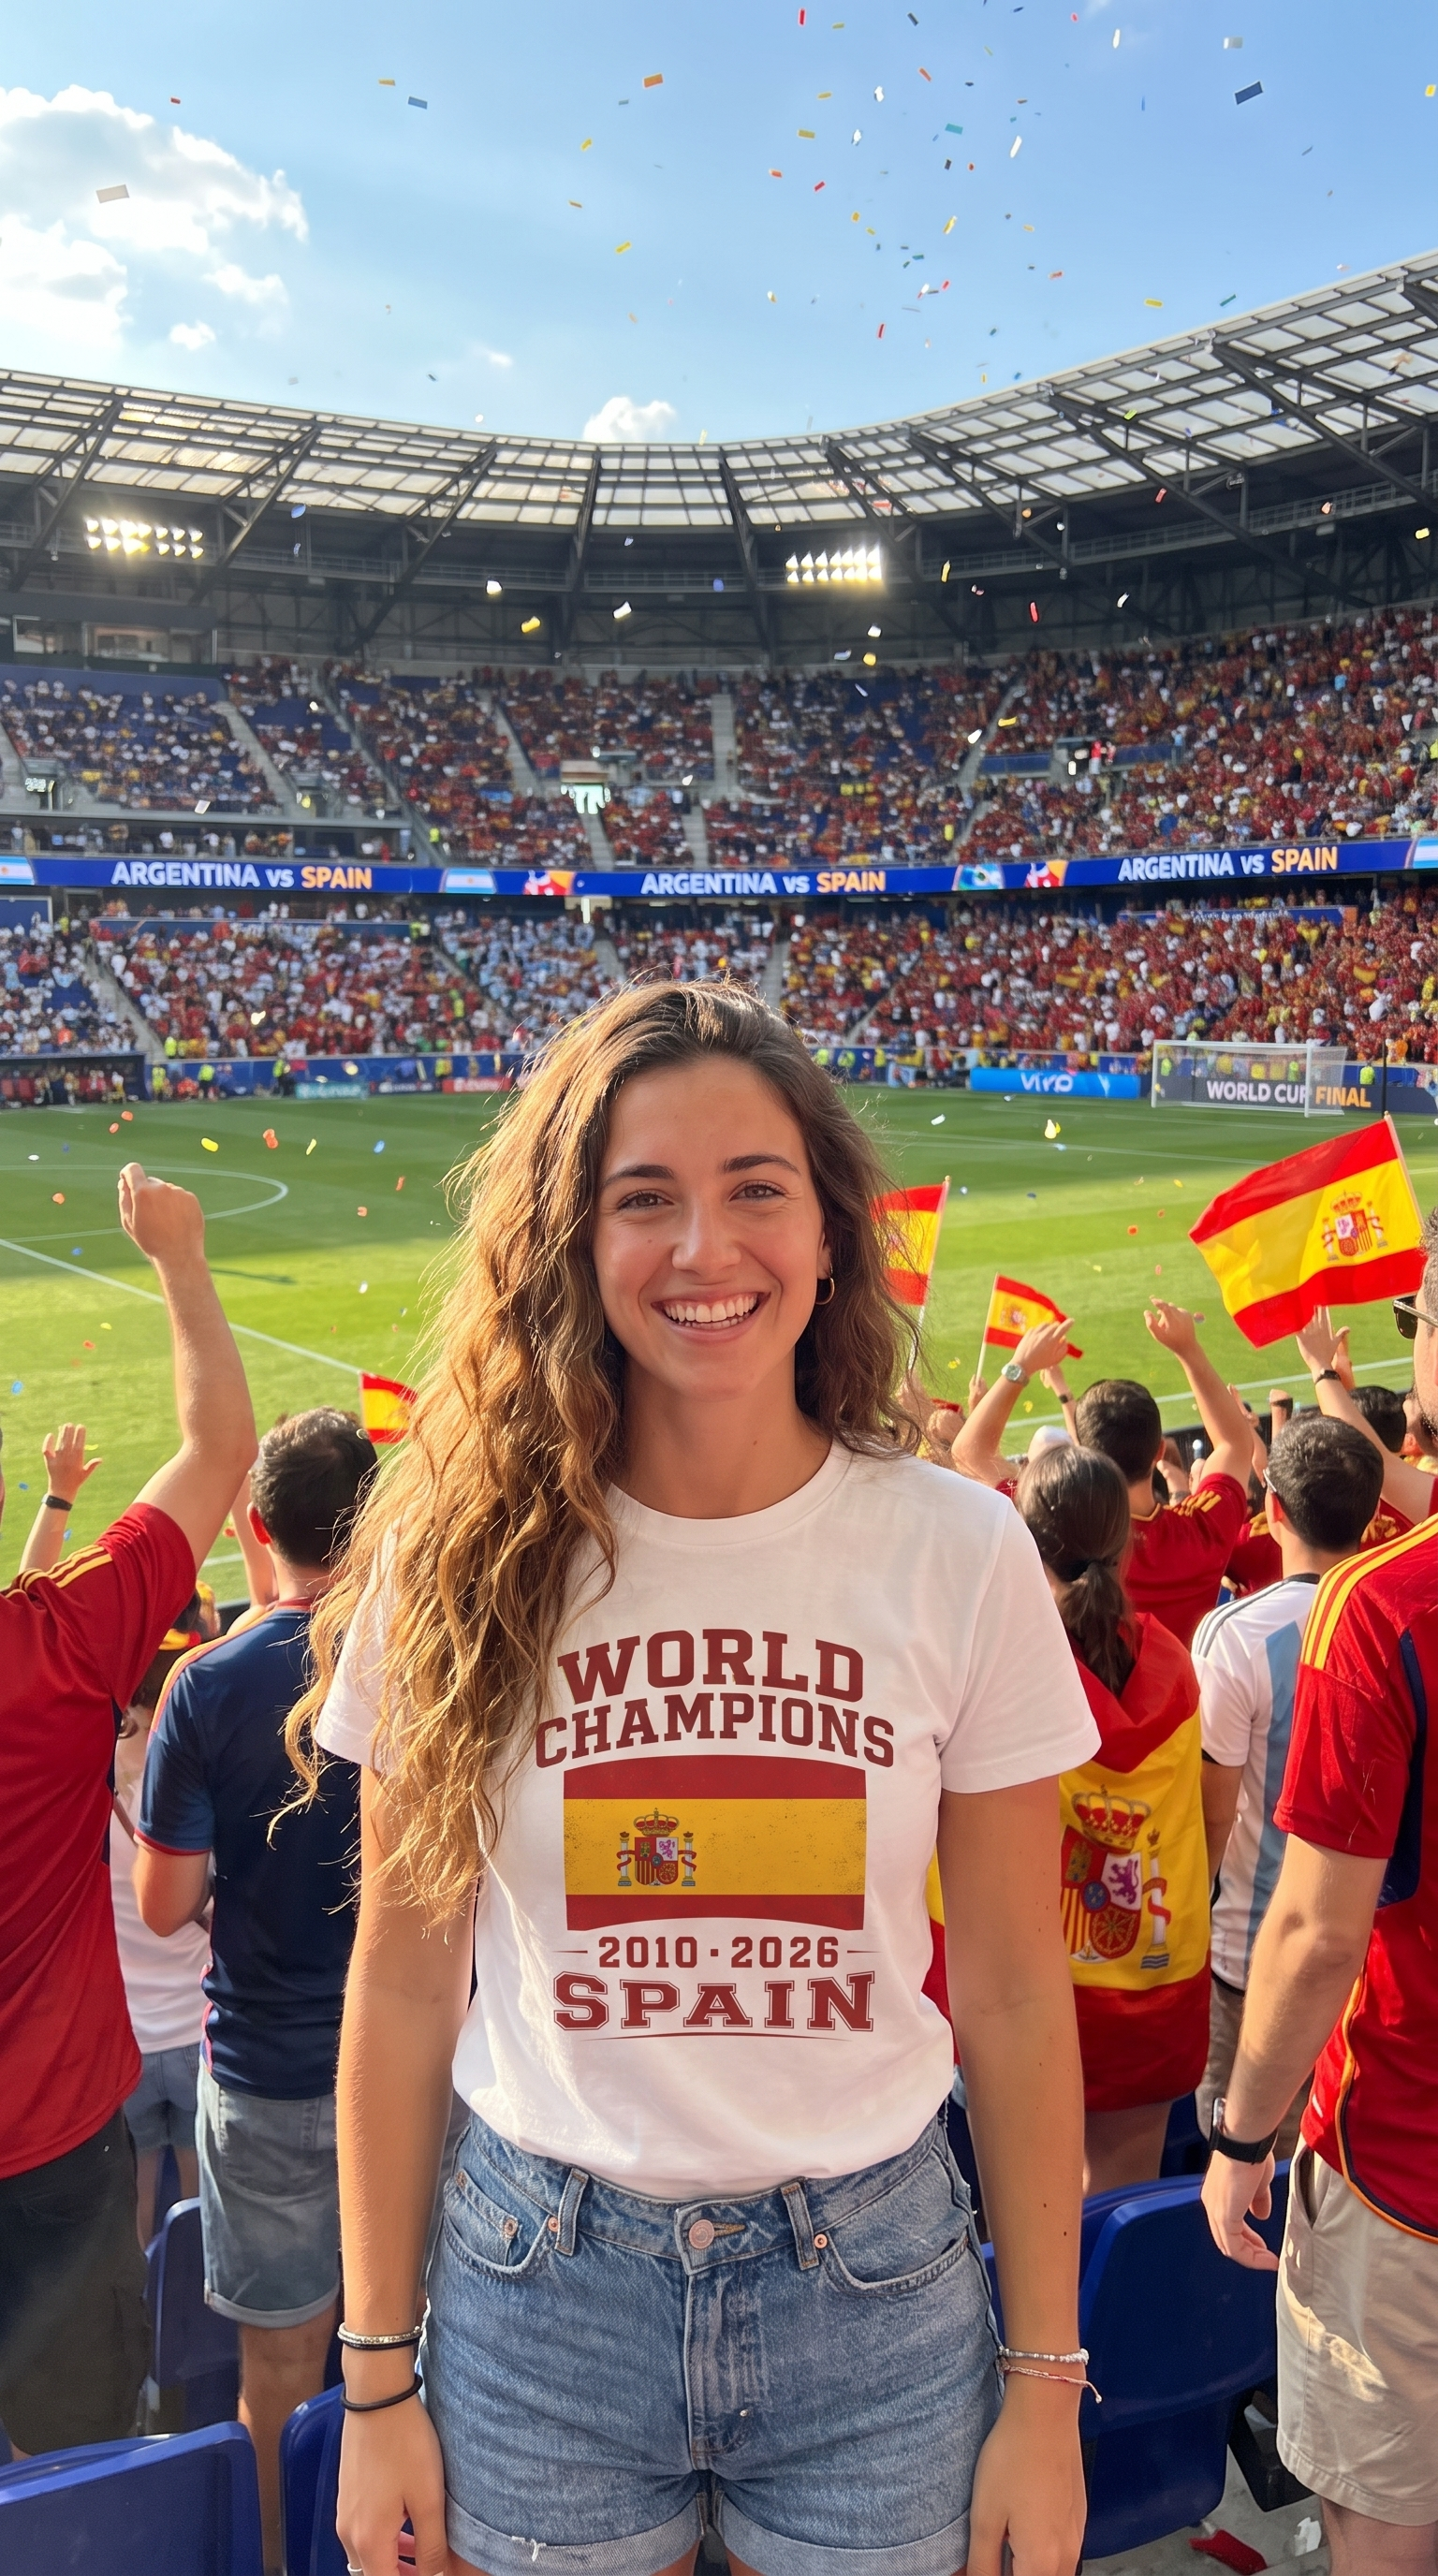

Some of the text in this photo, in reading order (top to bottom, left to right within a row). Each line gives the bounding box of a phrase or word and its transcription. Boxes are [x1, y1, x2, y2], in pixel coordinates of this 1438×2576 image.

[111, 861, 260, 886] ARGENTINA
[301, 866, 372, 889] SPAIN
[1118, 853, 1234, 881] ARGENTINA
[1271, 846, 1337, 873] SPAIN
[640, 872, 777, 895] ARGENTINA
[816, 871, 886, 892] SPAIN
[1207, 1080, 1270, 1103] WORLD
[1315, 1086, 1372, 1107] FINAL
[557, 1629, 863, 1705] WORLD
[536, 1692, 894, 1767] CHAMPIONS
[598, 1937, 697, 1968] 2010
[730, 1937, 839, 1969] 2026
[553, 1970, 875, 2031] SPAIN
